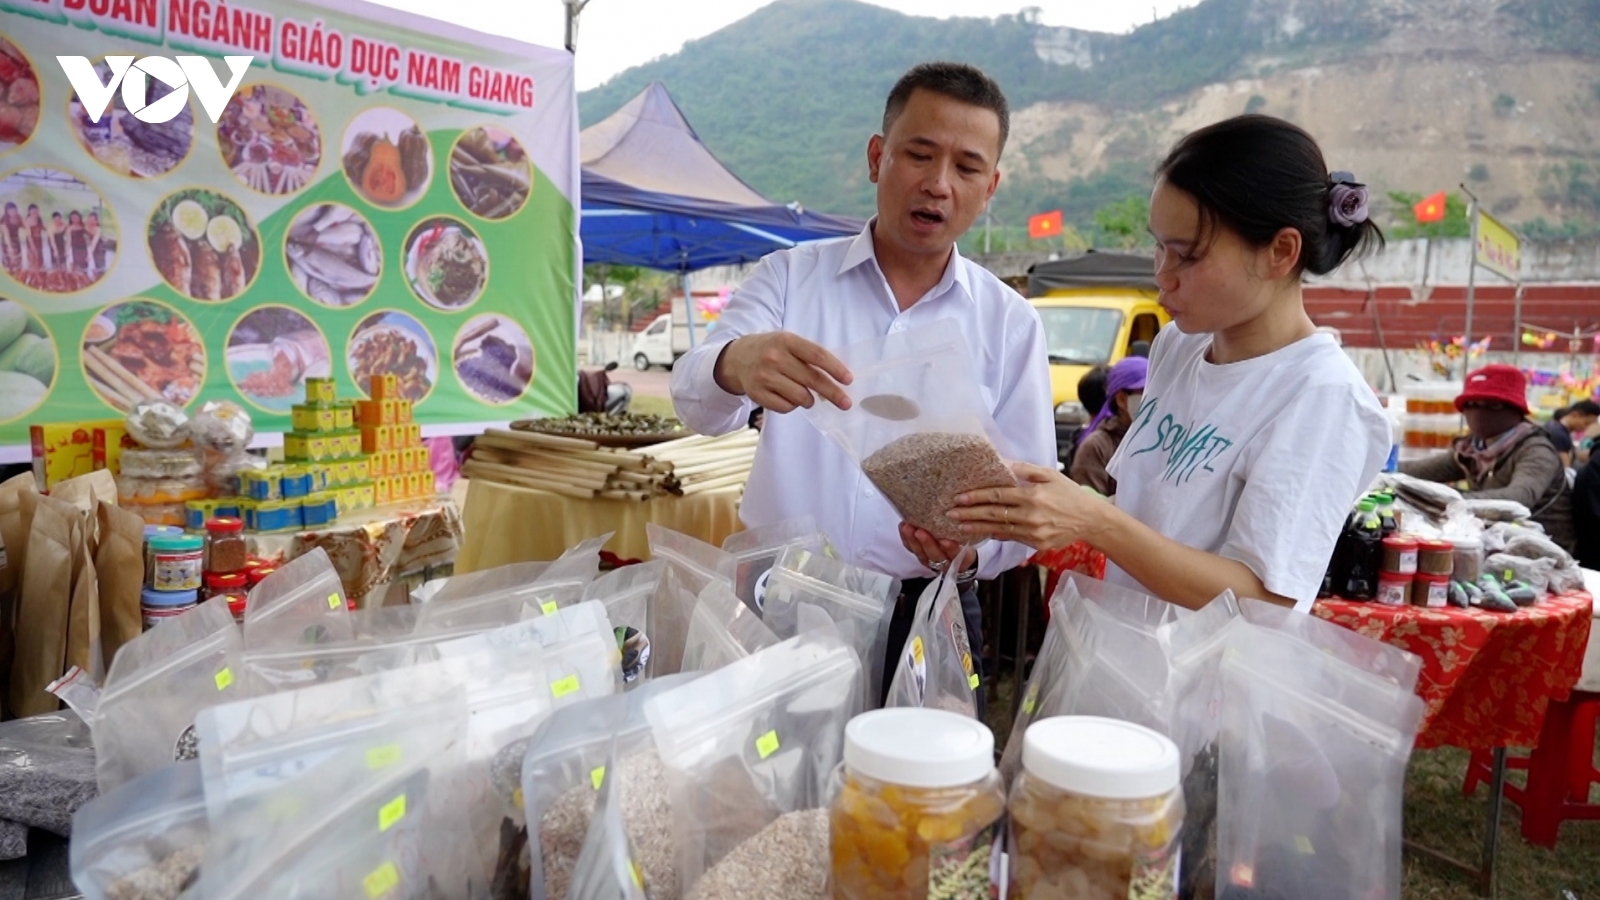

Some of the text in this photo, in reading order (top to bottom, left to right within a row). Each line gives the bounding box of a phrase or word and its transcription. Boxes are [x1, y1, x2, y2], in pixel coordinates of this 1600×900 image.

[281, 21, 342, 69] GIÁO
[351, 38, 399, 85] DỤC
[407, 51, 461, 94] NAM
[469, 65, 533, 108] GIANG
